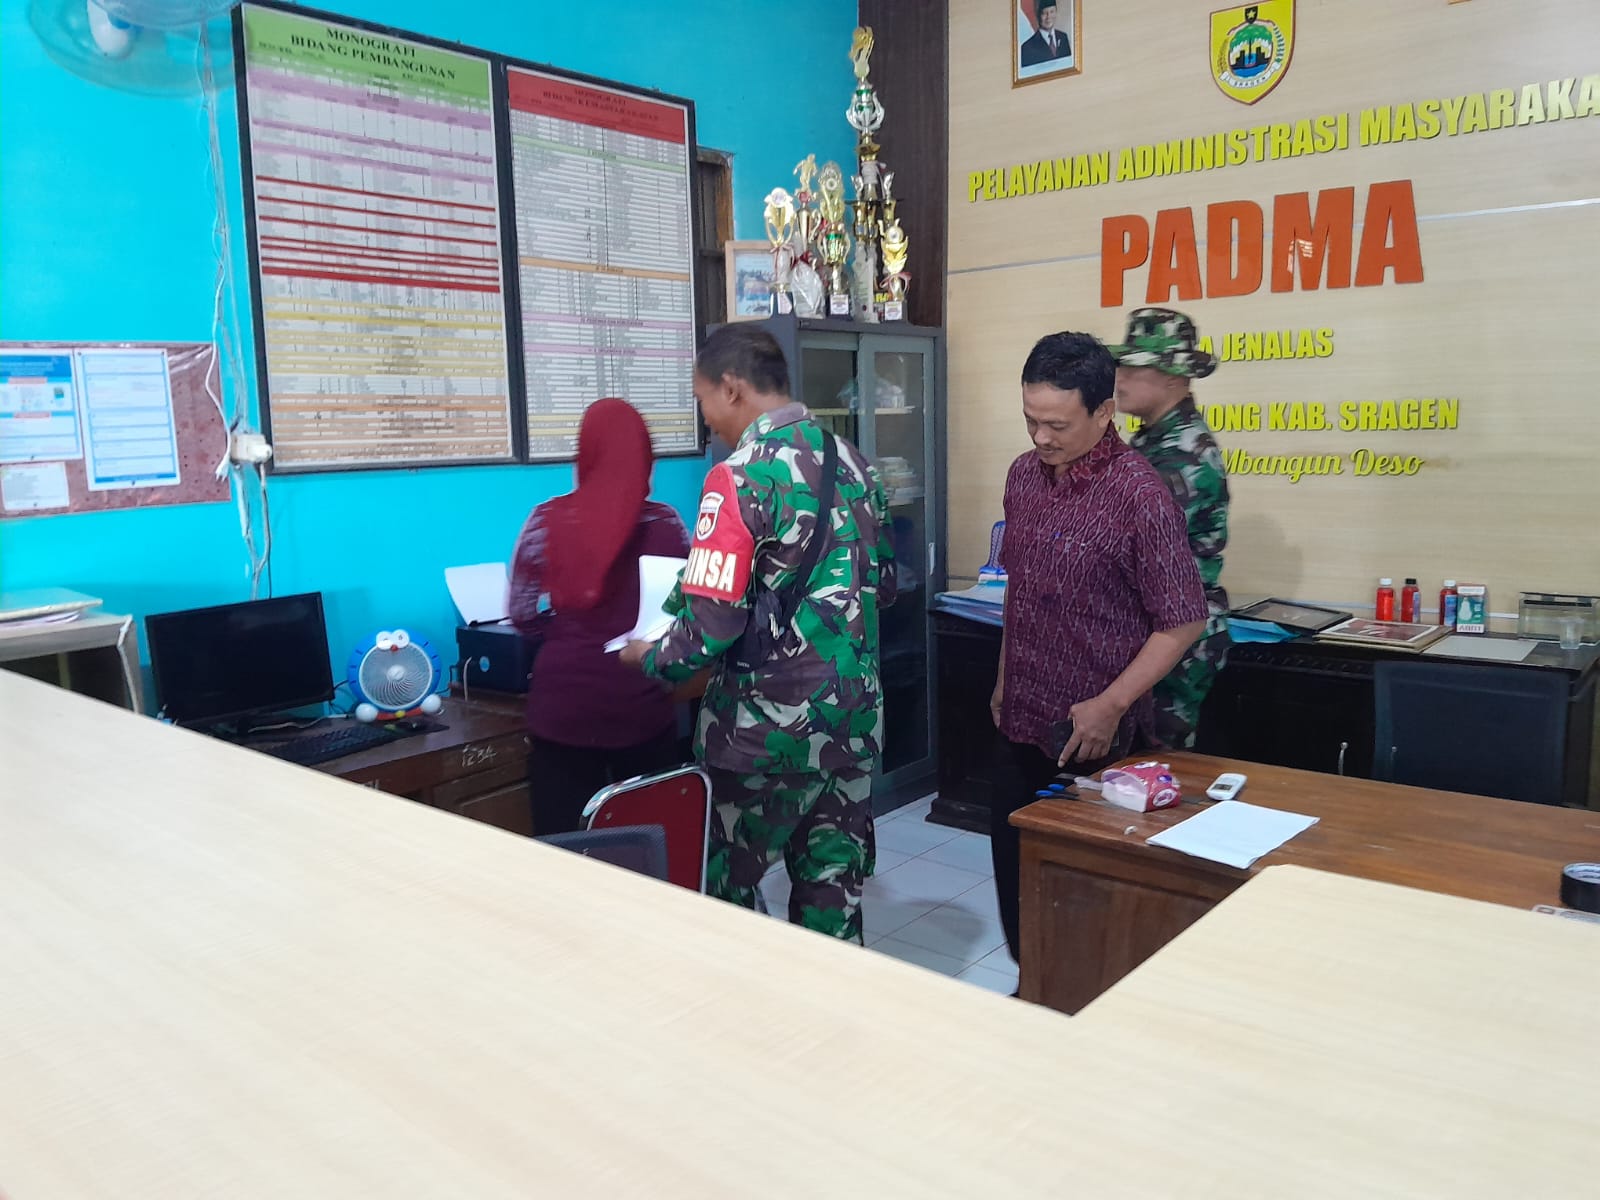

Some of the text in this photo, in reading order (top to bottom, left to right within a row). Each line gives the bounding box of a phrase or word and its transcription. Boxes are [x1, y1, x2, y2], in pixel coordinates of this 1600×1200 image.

[290, 35, 348, 57] BIDANG
[352, 48, 456, 80] PEMBANGUNAN
[327, 28, 416, 57] MONOGRAFI
[967, 150, 1110, 202] PELAYANAN
[1116, 112, 1349, 181] ADMINISTRASI
[1101, 179, 1424, 308] PADMA
[1220, 328, 1335, 362] JENALAS
[1269, 401, 1334, 431] KAB.
[1339, 398, 1459, 431] SRAGEN
[1350, 449, 1426, 476] Deso
